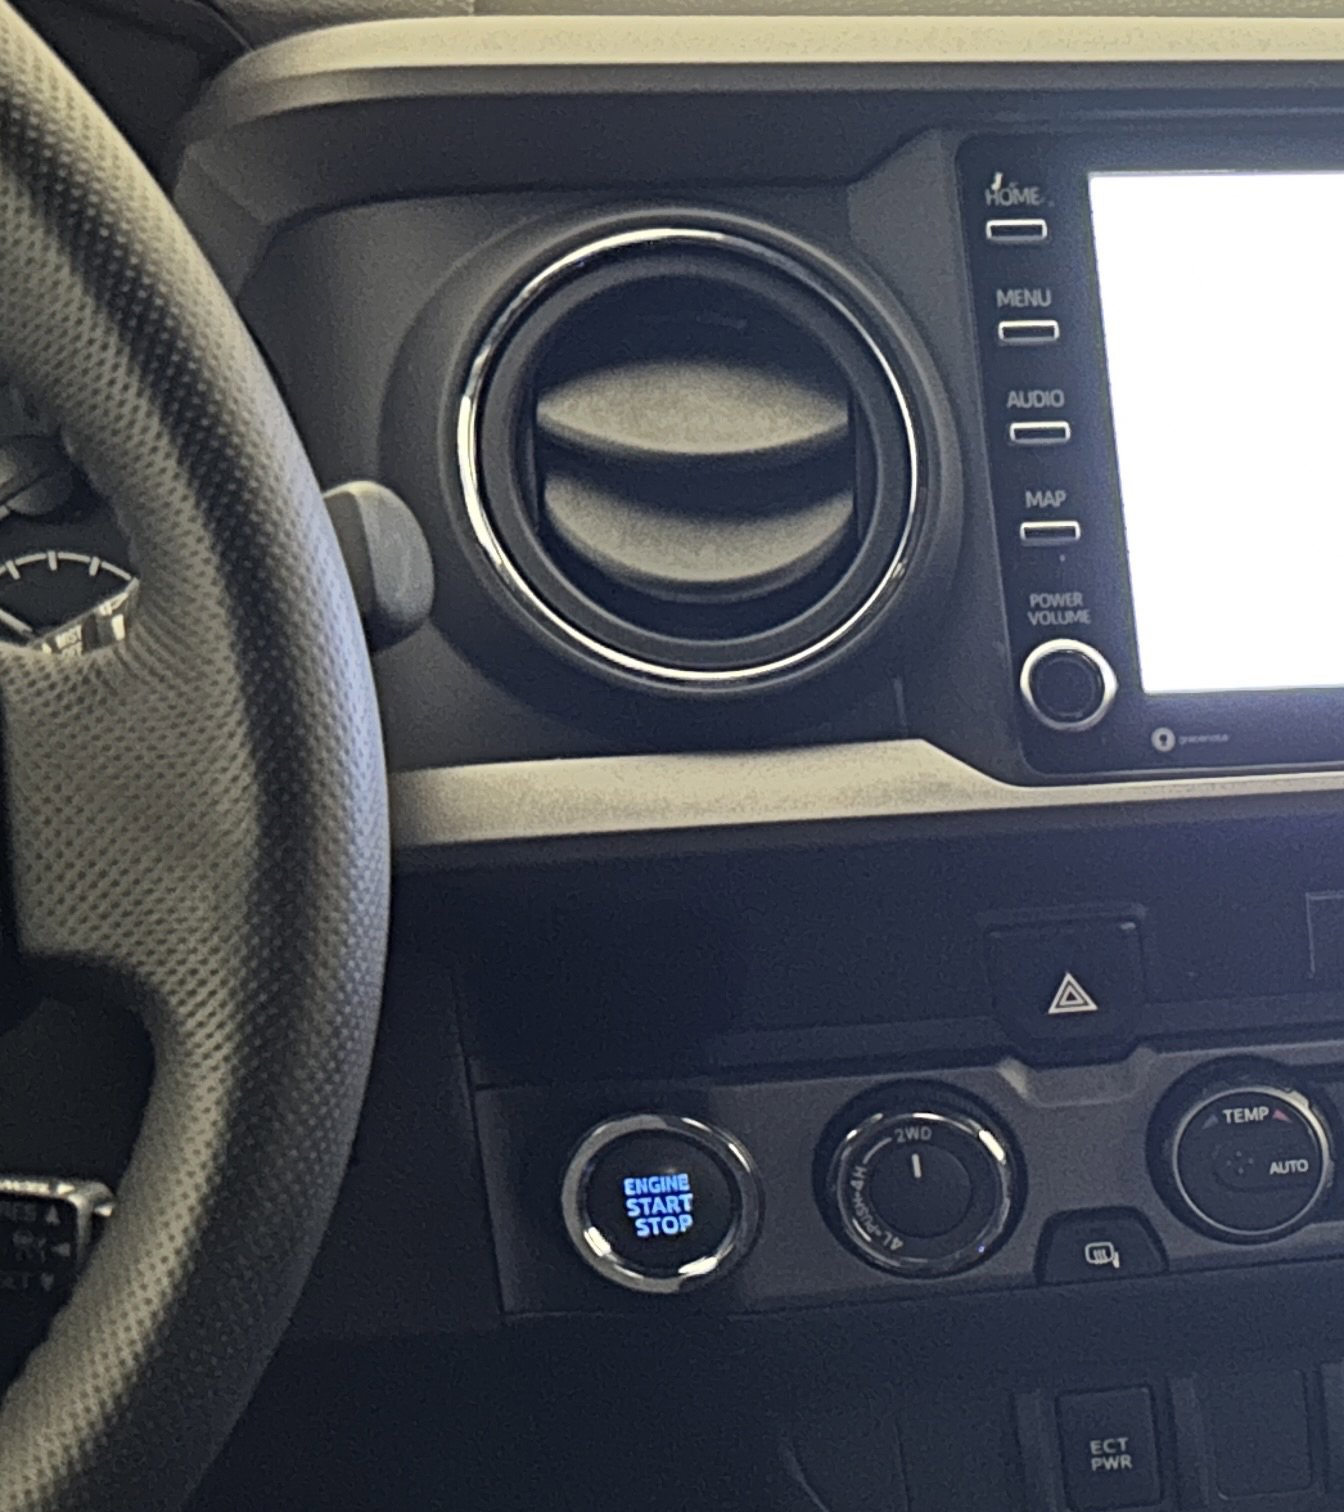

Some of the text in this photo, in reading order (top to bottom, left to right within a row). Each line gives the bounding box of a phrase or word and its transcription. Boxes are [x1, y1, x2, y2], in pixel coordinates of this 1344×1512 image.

[985, 186, 1040, 206] HOME
[996, 289, 1051, 307] MENU
[1006, 390, 1065, 409] AUDIO
[1026, 490, 1067, 508] MAP
[1030, 592, 1083, 607] POWER
[1028, 609, 1091, 625] VOLUME
[1223, 1106, 1269, 1124] TEMP
[895, 1127, 932, 1143] 2WD
[1269, 1159, 1309, 1175] AUTO
[624, 1173, 690, 1195] ENGINE
[626, 1193, 693, 1217] START
[635, 1214, 693, 1237] STOP
[1090, 1437, 1129, 1456] ECT
[1091, 1454, 1133, 1471] PWR
